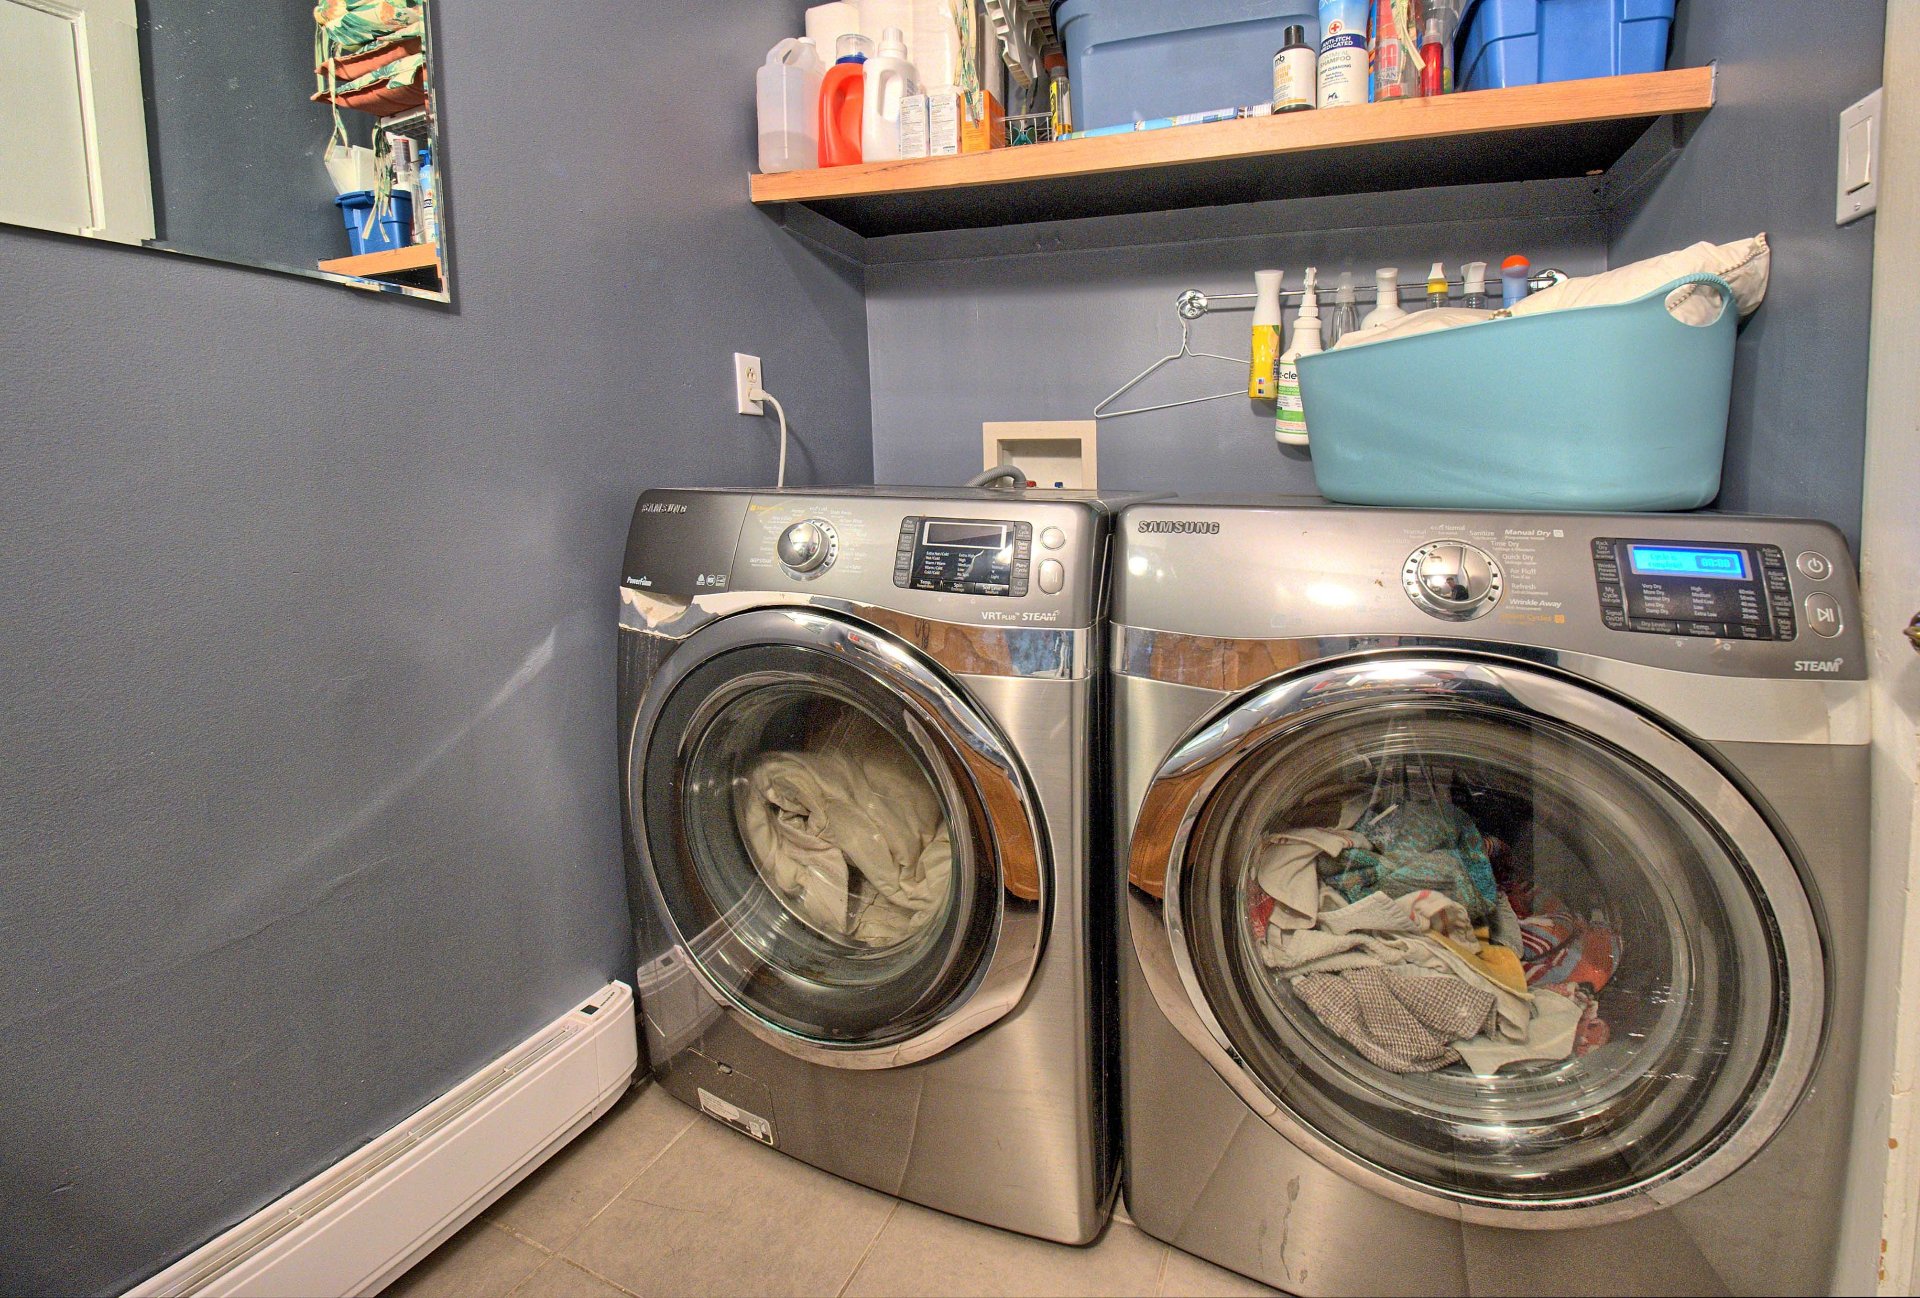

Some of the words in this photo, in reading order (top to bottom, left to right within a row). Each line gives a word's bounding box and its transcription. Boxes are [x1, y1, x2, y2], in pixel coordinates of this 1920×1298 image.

[1320, 41, 1353, 53] MEDICATED
[1322, 36, 1351, 47] ANTI-ITCH
[1320, 56, 1352, 68] SHAMPOO
[641, 503, 688, 515] SAMSUNG
[1138, 520, 1220, 534] SAMSUNG
[1536, 530, 1552, 538] Dry
[1508, 540, 1520, 548] Dry
[1539, 600, 1562, 608] Away
[1022, 612, 1057, 621] STEAM
[1794, 659, 1841, 672] STEAM
